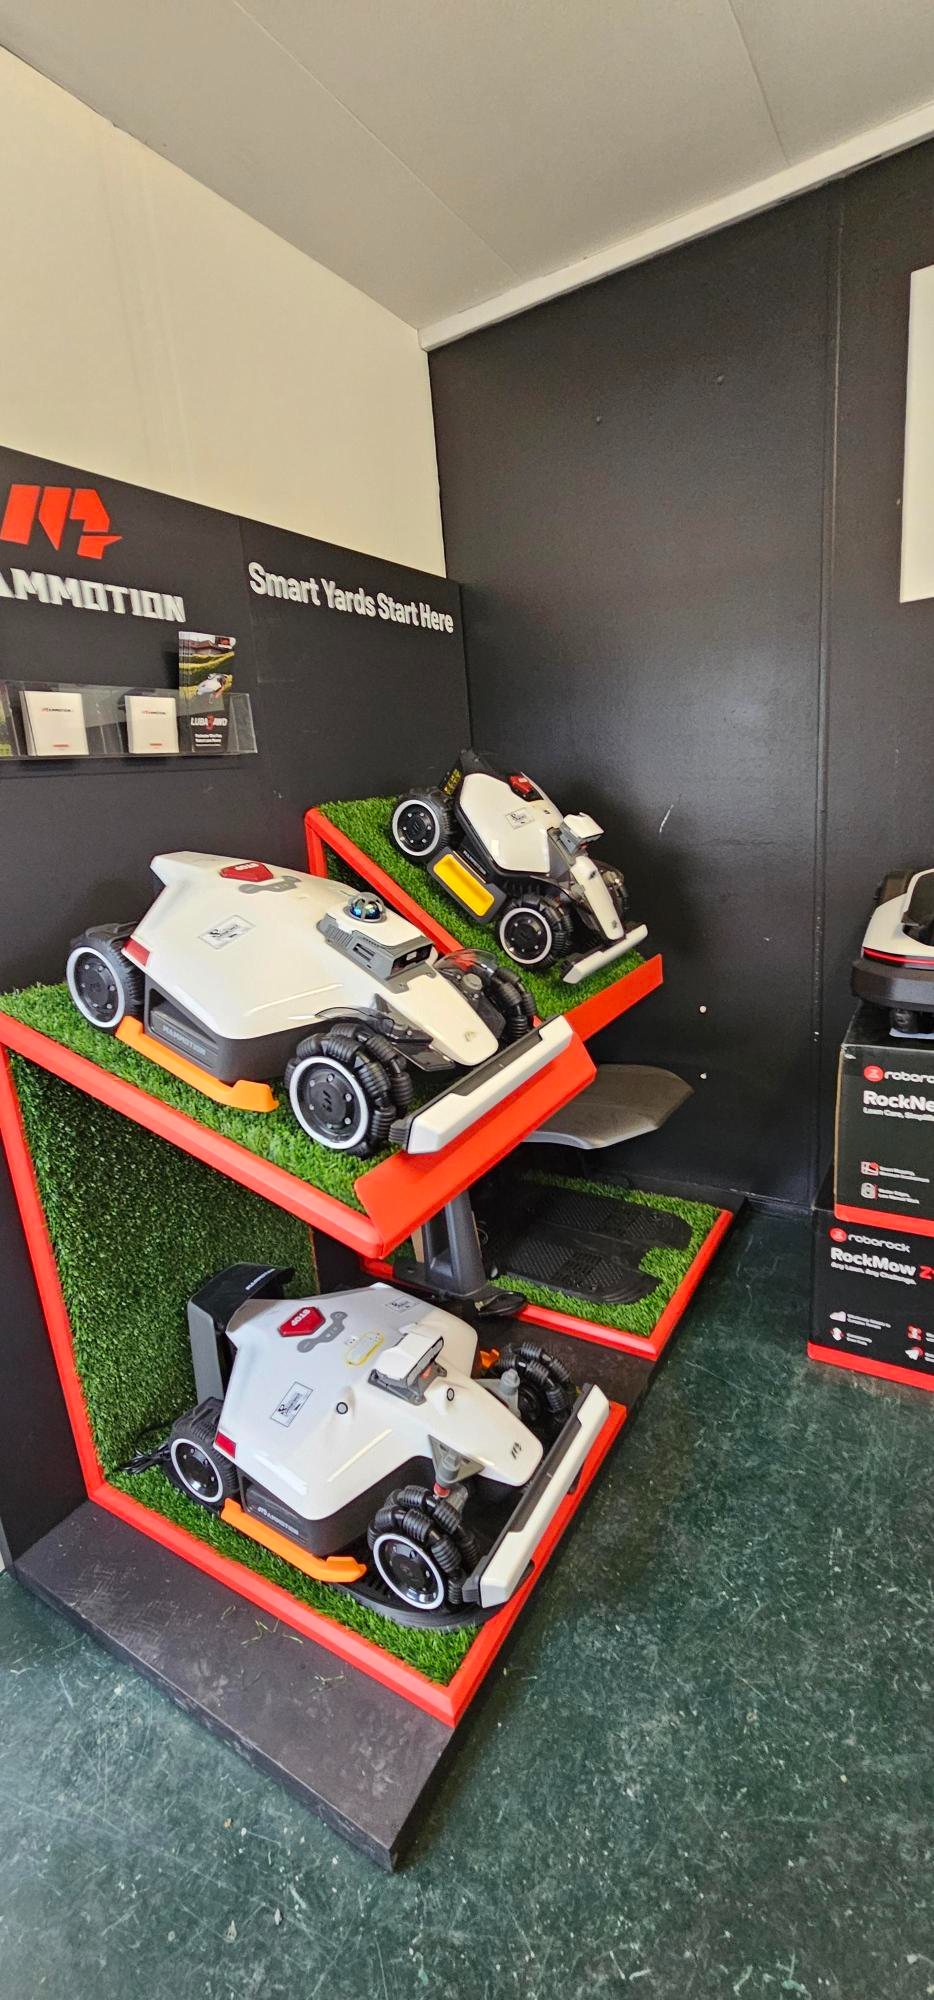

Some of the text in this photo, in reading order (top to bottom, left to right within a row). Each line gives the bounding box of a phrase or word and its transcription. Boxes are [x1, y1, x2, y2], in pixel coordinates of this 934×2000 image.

[248, 561, 454, 634] Smart Yards Start Here
[848, 1233, 911, 1253] roborock
[830, 1246, 934, 1280] RockMow Z
[291, 1308, 311, 1327] STOP
